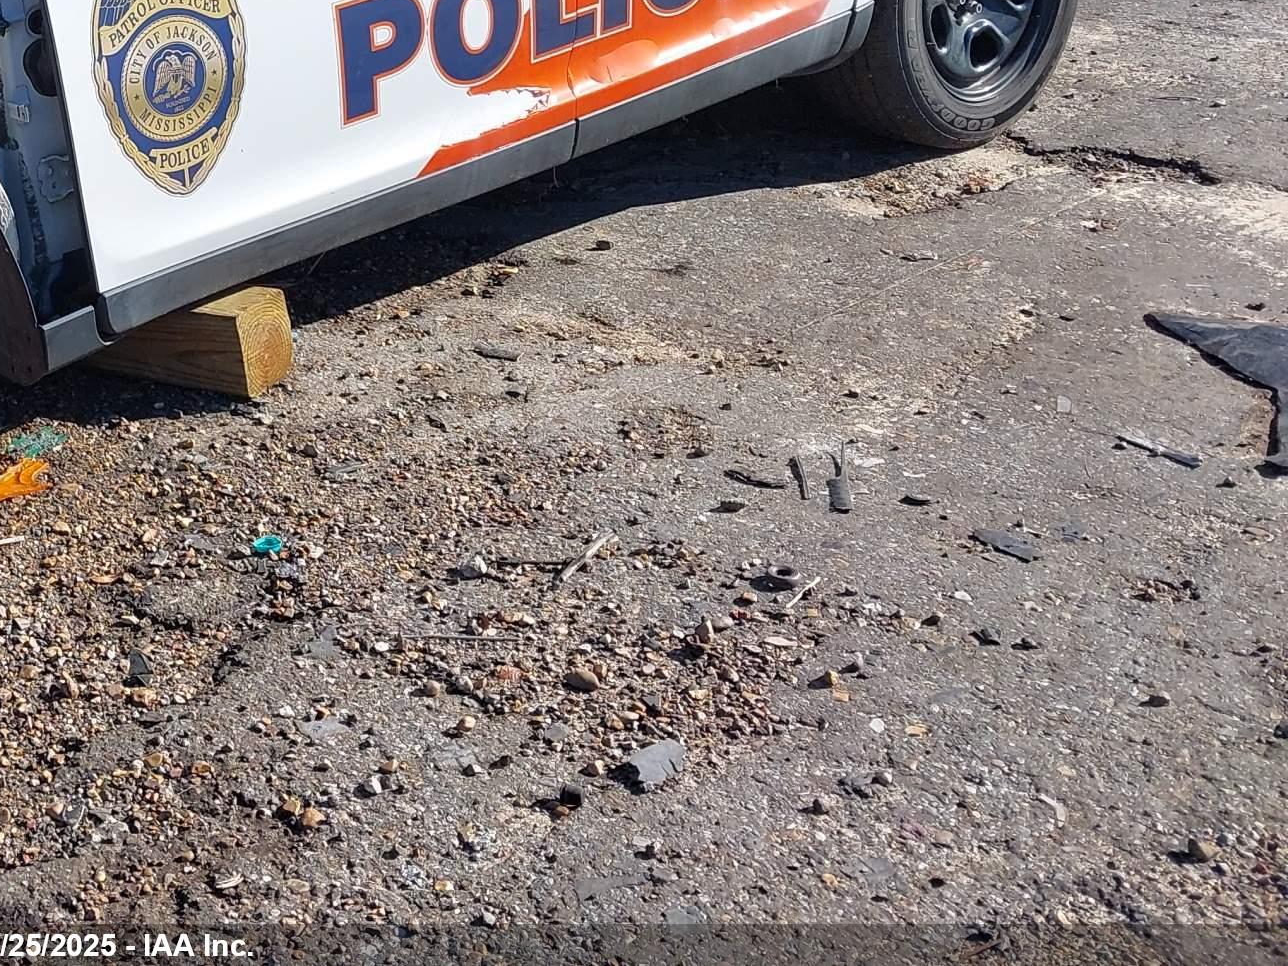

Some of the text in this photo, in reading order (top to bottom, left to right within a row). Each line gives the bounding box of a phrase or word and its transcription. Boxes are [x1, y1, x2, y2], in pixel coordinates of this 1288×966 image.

[130, 25, 218, 84] CITY OF JACKSON
[139, 86, 217, 132] MISSISSIPPI
[159, 139, 210, 169] POLICE
